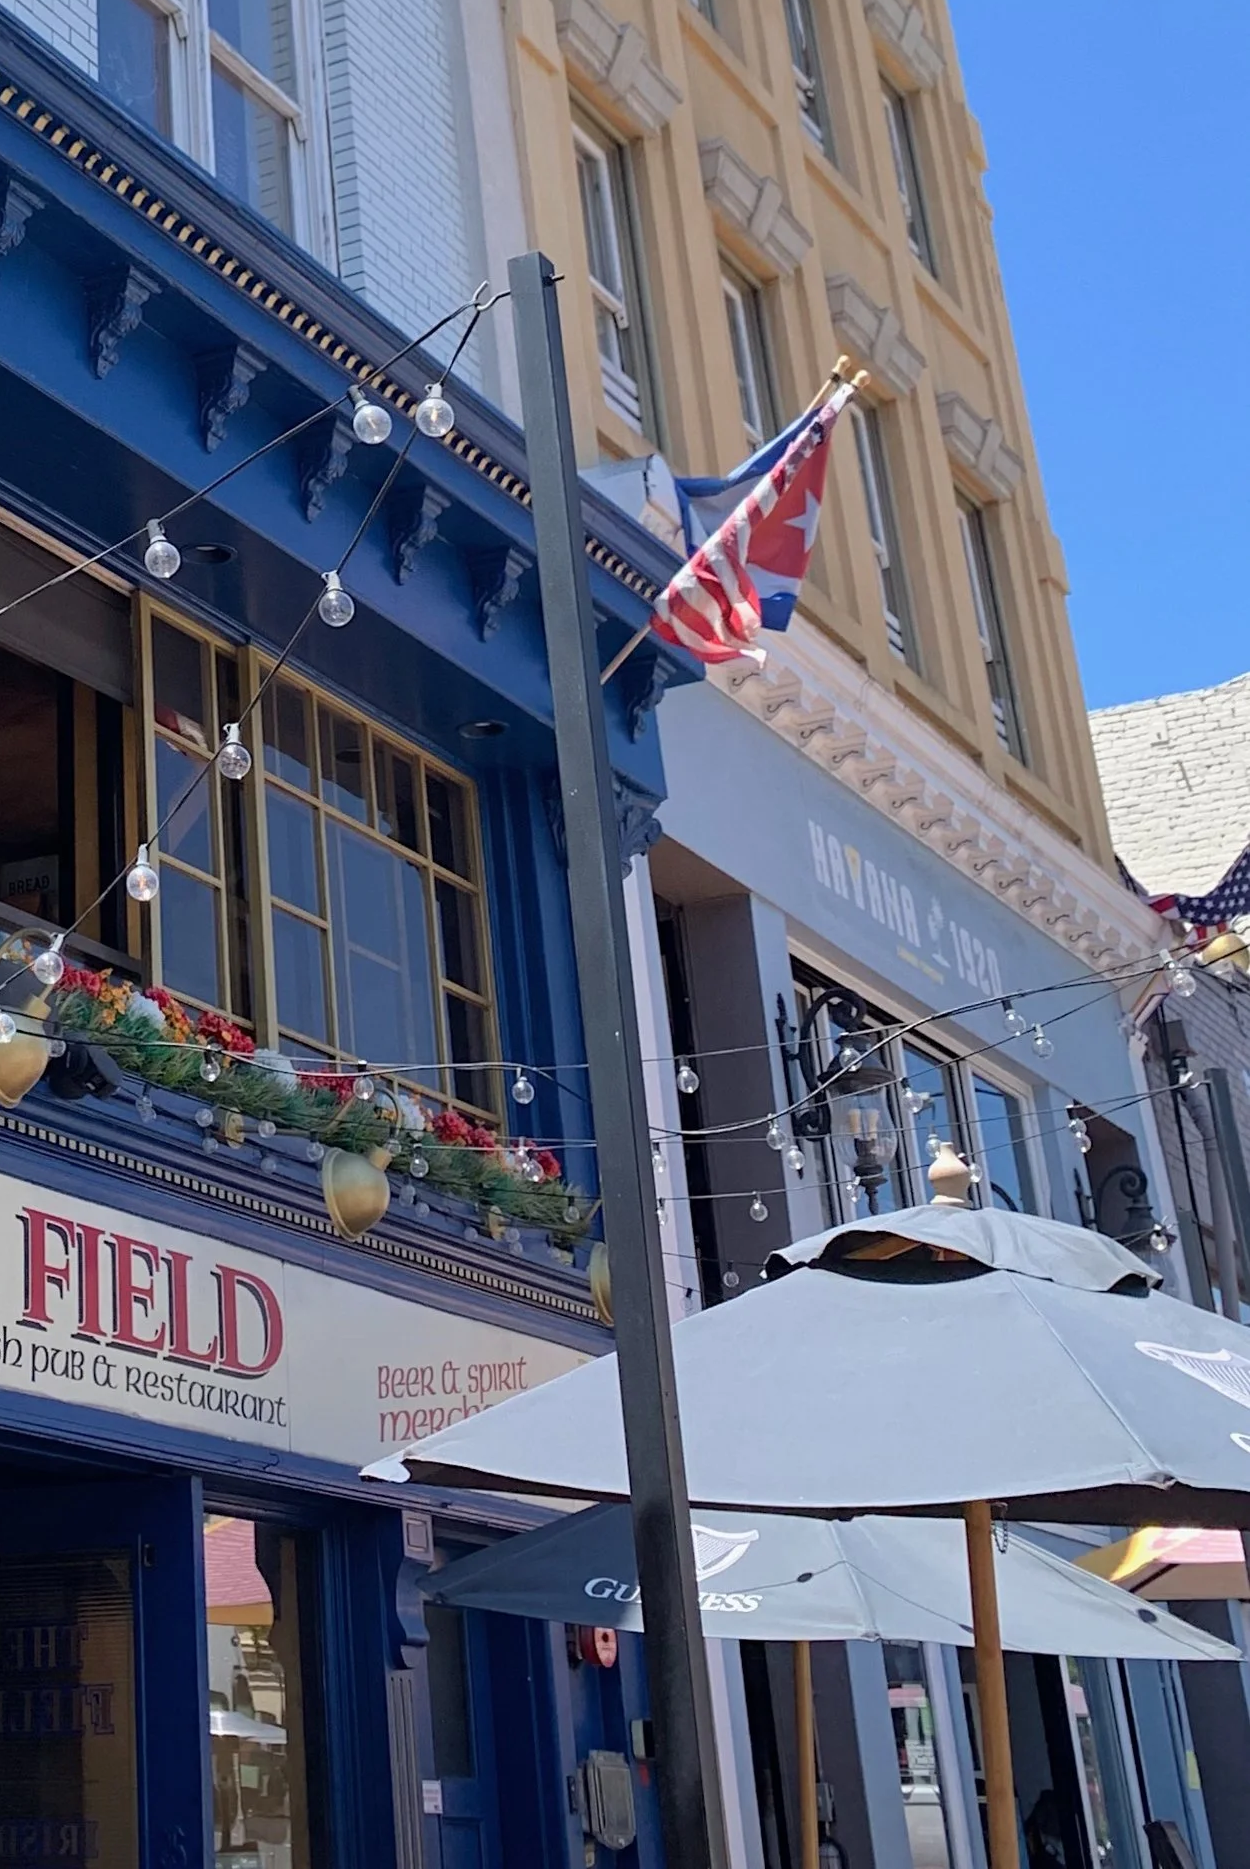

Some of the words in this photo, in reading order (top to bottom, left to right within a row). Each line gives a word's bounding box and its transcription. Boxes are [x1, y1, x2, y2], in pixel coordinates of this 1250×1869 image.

[8, 875, 50, 894] BREAD
[16, 1205, 285, 1380] FIELD
[91, 1353, 120, 1392] &
[123, 1363, 288, 1428] restaurant
[584, 1577, 763, 1613] GUESS
